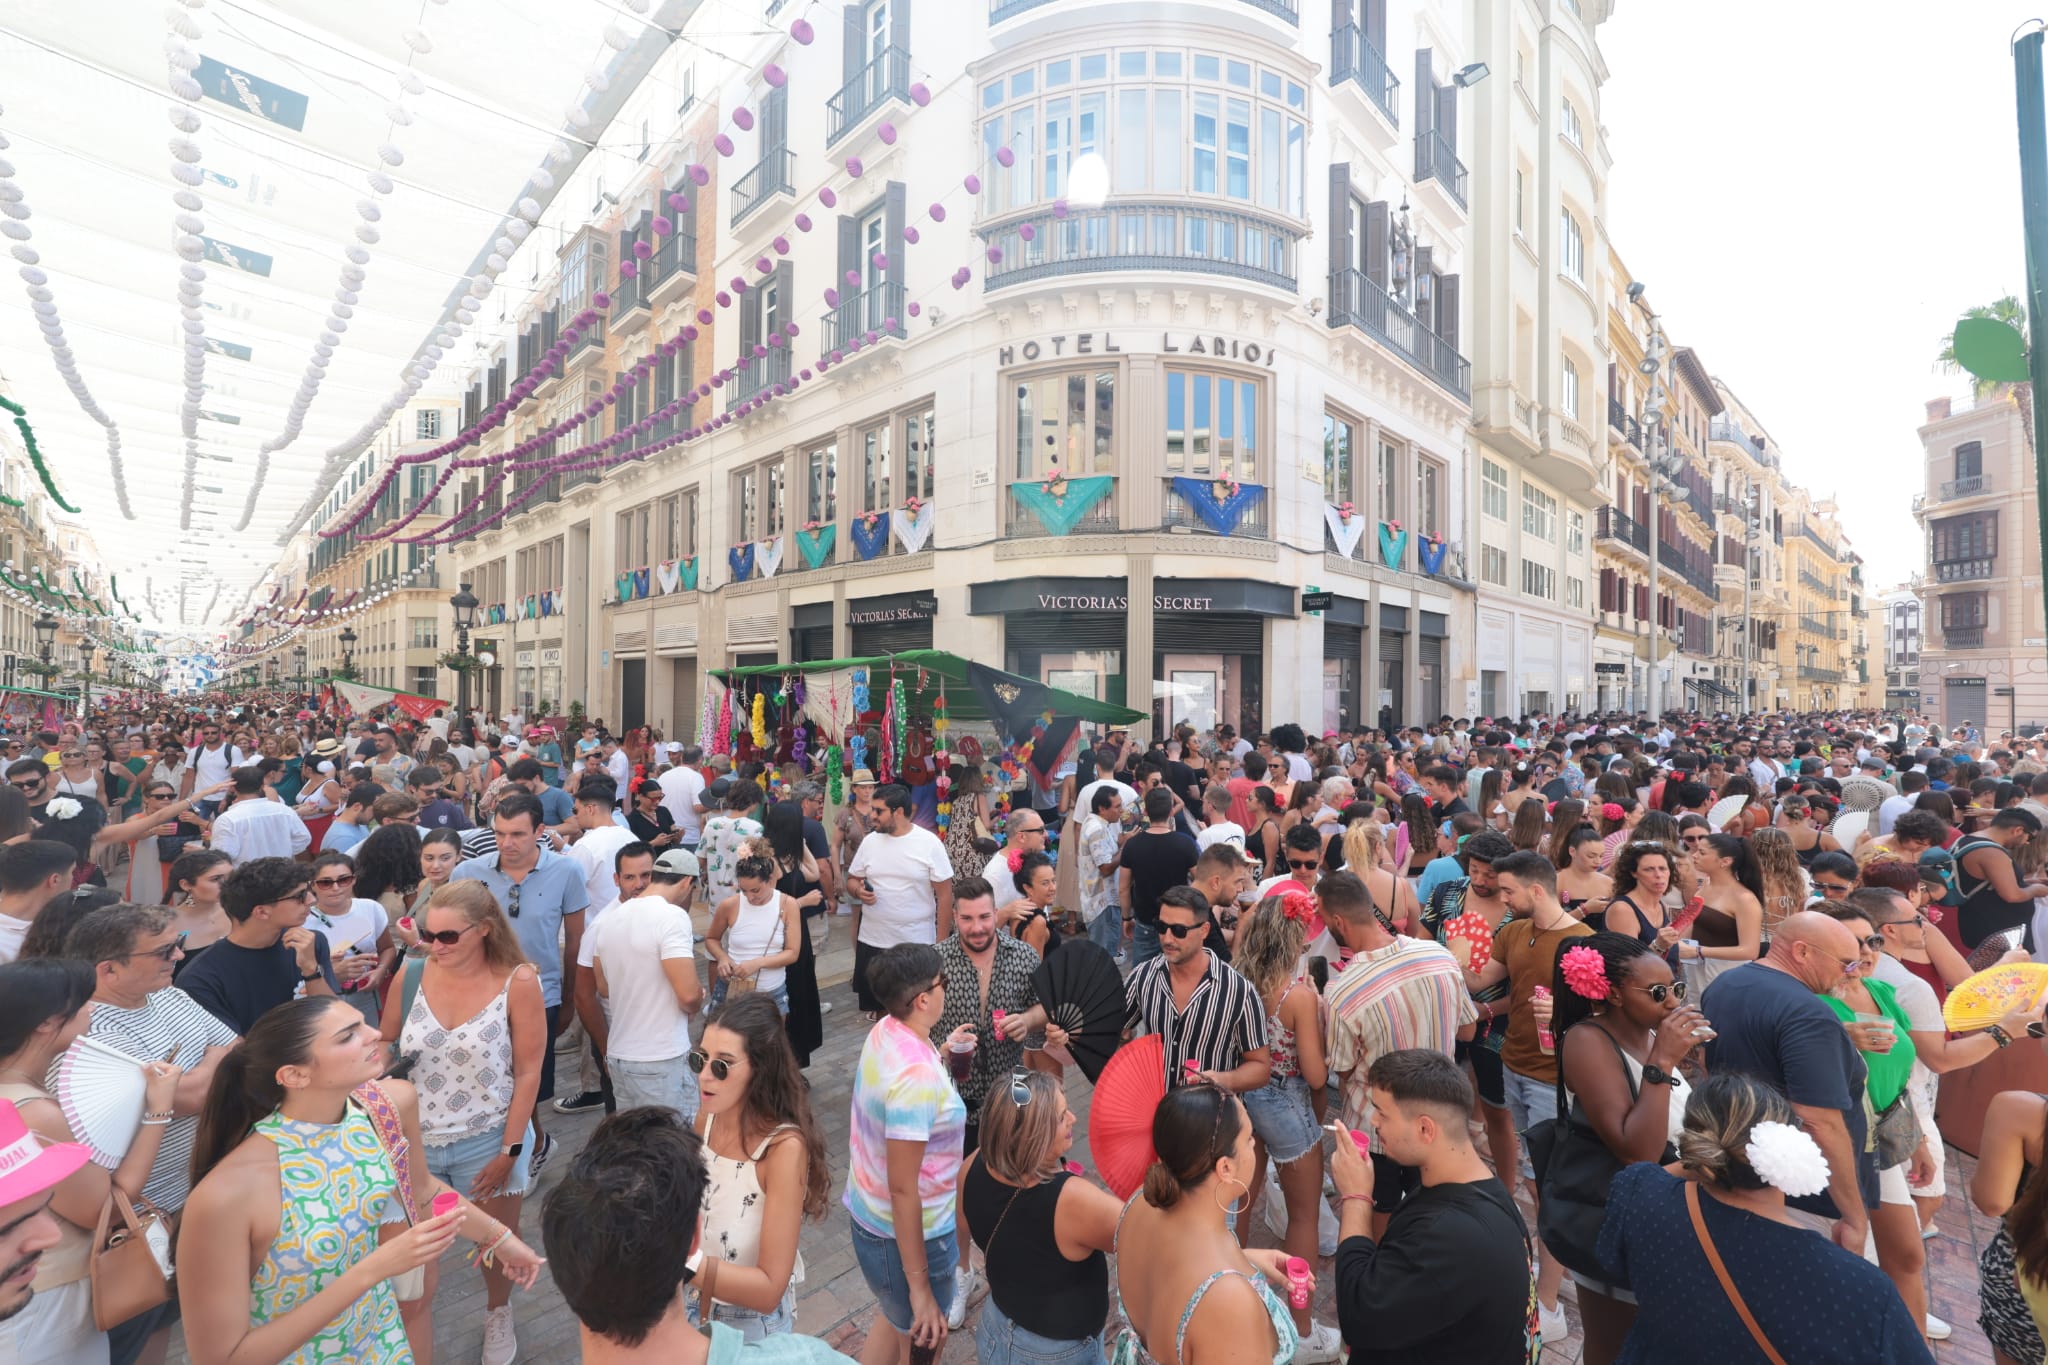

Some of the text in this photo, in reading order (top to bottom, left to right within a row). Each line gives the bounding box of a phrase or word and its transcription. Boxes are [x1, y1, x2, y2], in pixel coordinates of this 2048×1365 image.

[999, 331, 1276, 366] HOTEL LARIOS
[1038, 594, 1212, 610] VICTORIA'S SECRET
[851, 609, 895, 624] VICTORIA'S
[545, 650, 559, 661] KIKO
